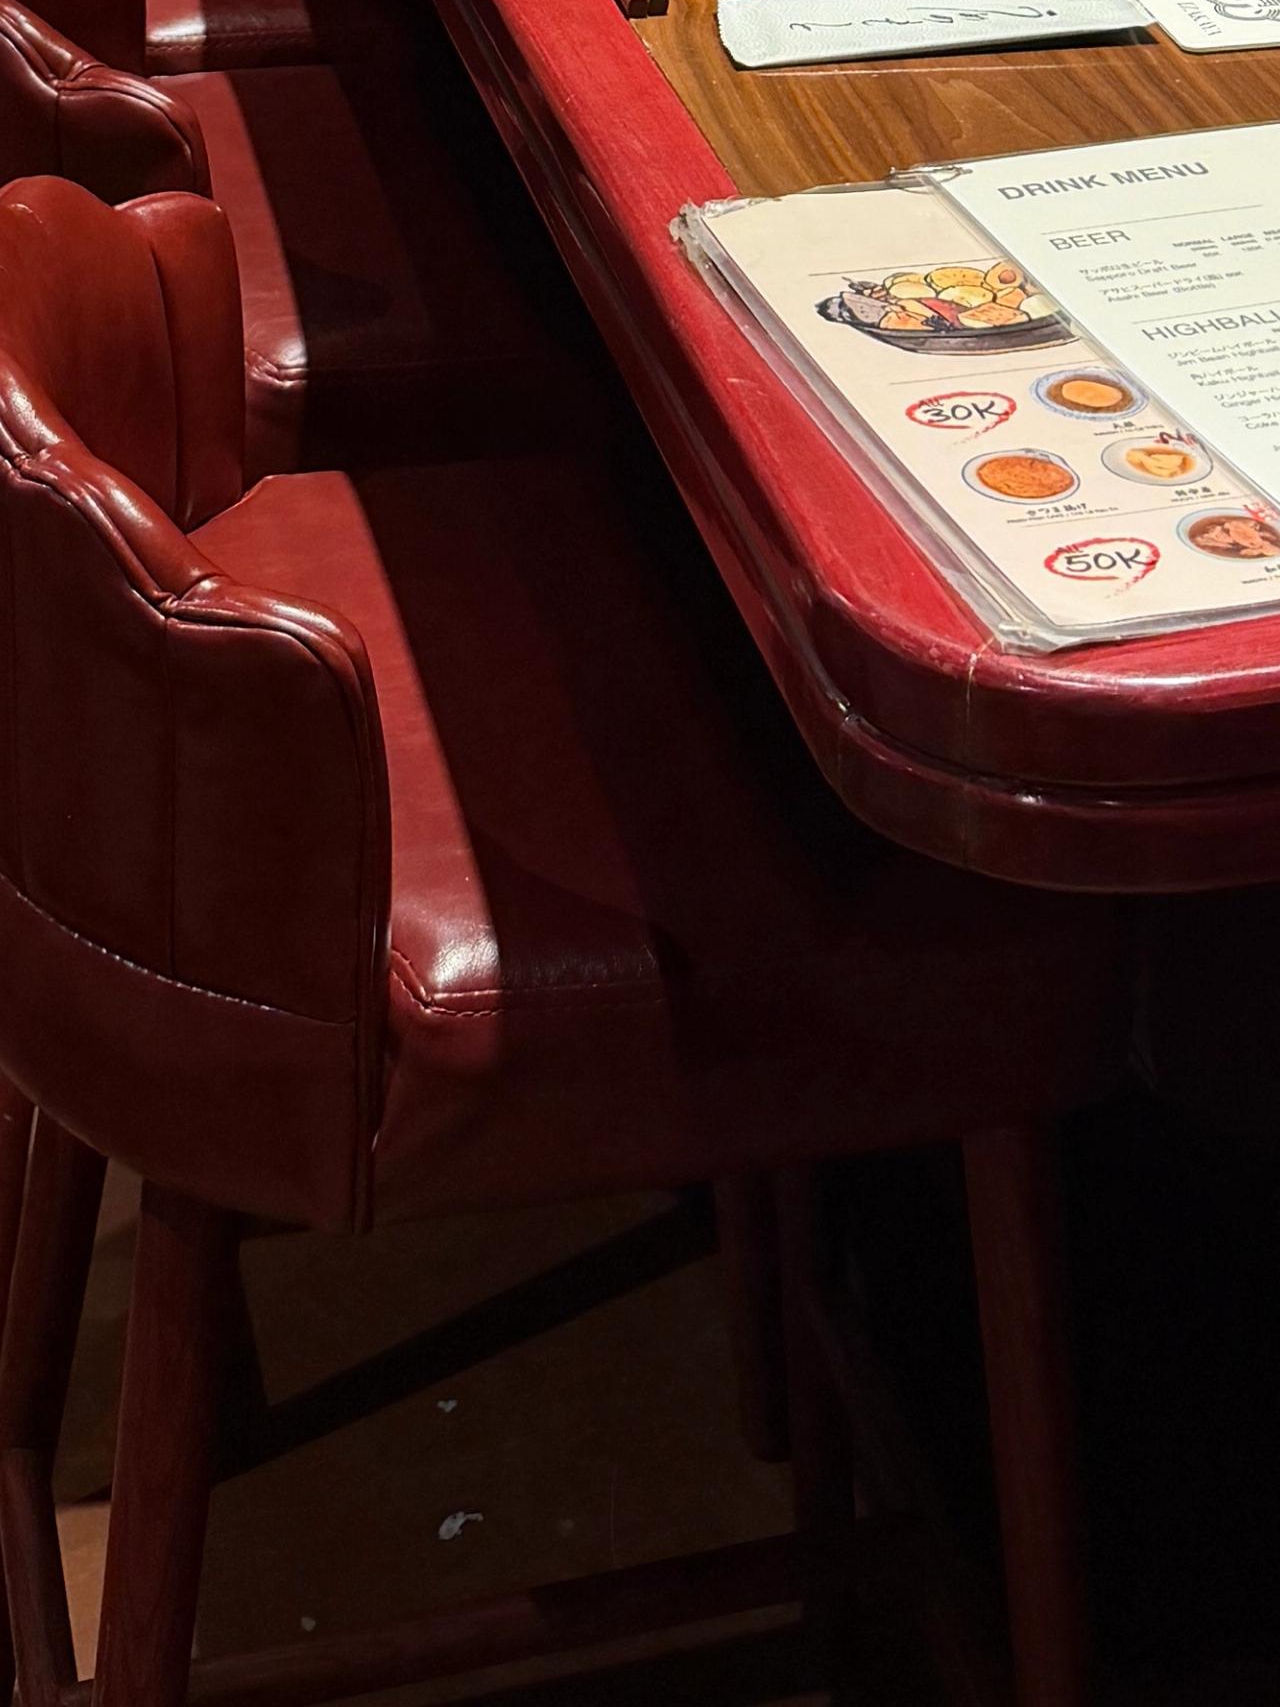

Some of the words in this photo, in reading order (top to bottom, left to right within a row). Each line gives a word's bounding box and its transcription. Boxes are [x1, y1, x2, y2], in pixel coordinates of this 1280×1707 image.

[998, 171, 1105, 201] DRINK
[1110, 160, 1210, 187] MENU
[1049, 227, 1132, 251] BEER
[922, 400, 1008, 425] 30K
[1065, 547, 1149, 573] 50K
